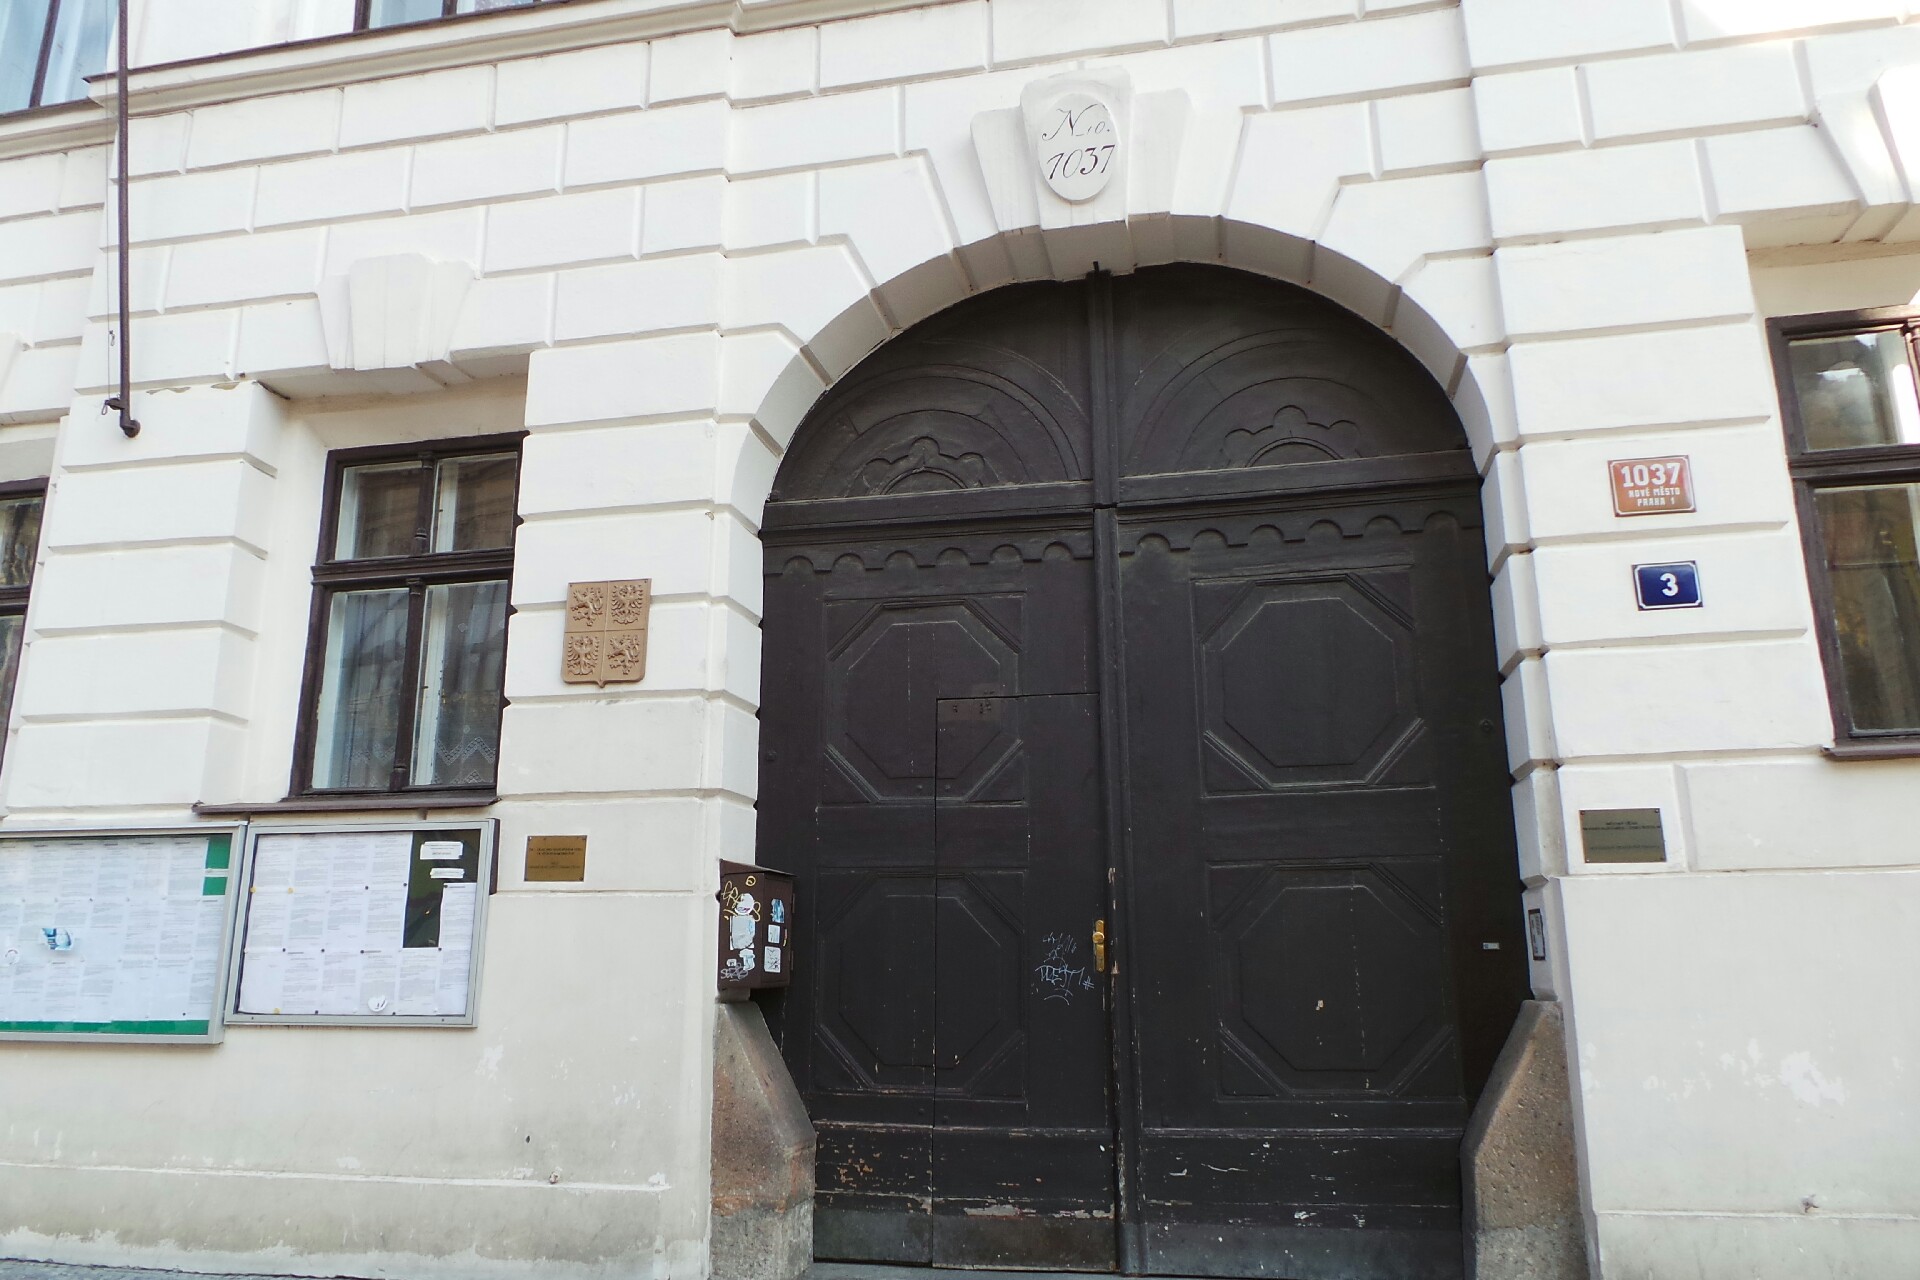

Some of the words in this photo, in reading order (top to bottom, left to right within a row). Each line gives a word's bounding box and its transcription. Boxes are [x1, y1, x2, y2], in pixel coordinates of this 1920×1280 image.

[1046, 144, 1115, 180] 1037
[1620, 462, 1681, 488] 1037
[1628, 486, 1651, 498] NOVÉ
[1652, 485, 1681, 496] MĚSTO
[1637, 497, 1666, 507] PRAHA
[1670, 496, 1675, 505] 1
[1660, 572, 1679, 597] 3
